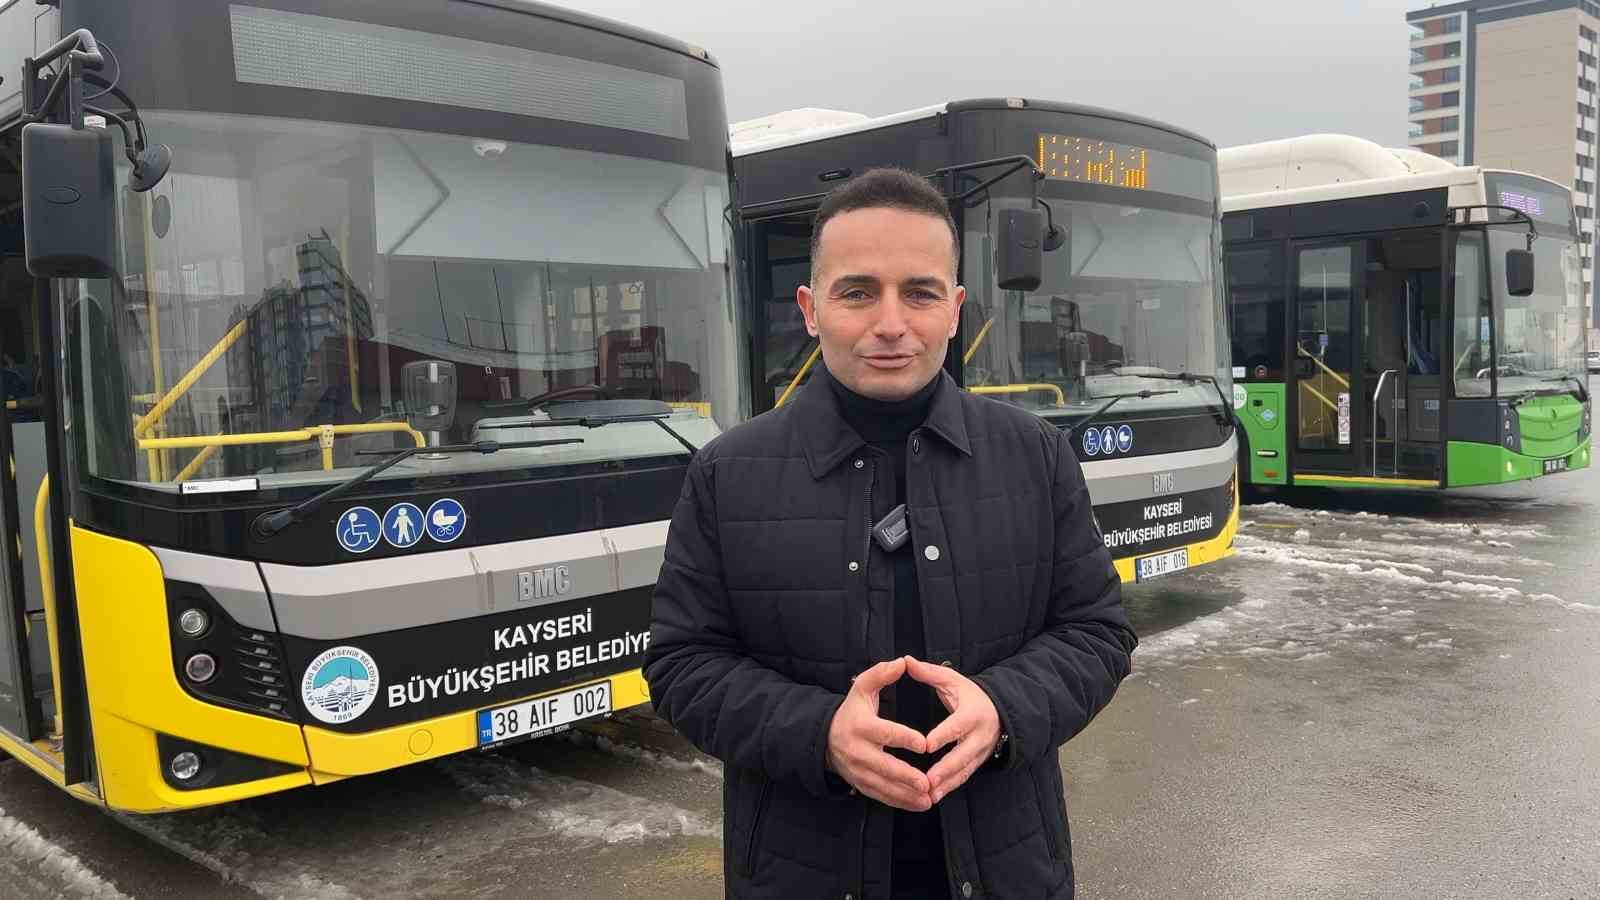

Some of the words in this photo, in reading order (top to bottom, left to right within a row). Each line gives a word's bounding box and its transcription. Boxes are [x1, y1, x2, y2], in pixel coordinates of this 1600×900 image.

[1143, 498, 1183, 521] KAYSERİ
[1103, 522, 1166, 548] BÜYÜKŞEHİR
[1166, 512, 1212, 538] BELEDİYESİ
[1142, 559, 1153, 576] 38
[1156, 555, 1168, 574] AIF
[1173, 551, 1186, 569] 016
[516, 565, 570, 601] BMC
[493, 608, 592, 651] KAYSERİ
[387, 651, 550, 708] BÜYÜKŞEHİR
[495, 709, 519, 736] 38
[530, 698, 559, 729] AIF
[574, 687, 606, 716] 002
[481, 729, 492, 737] TR
